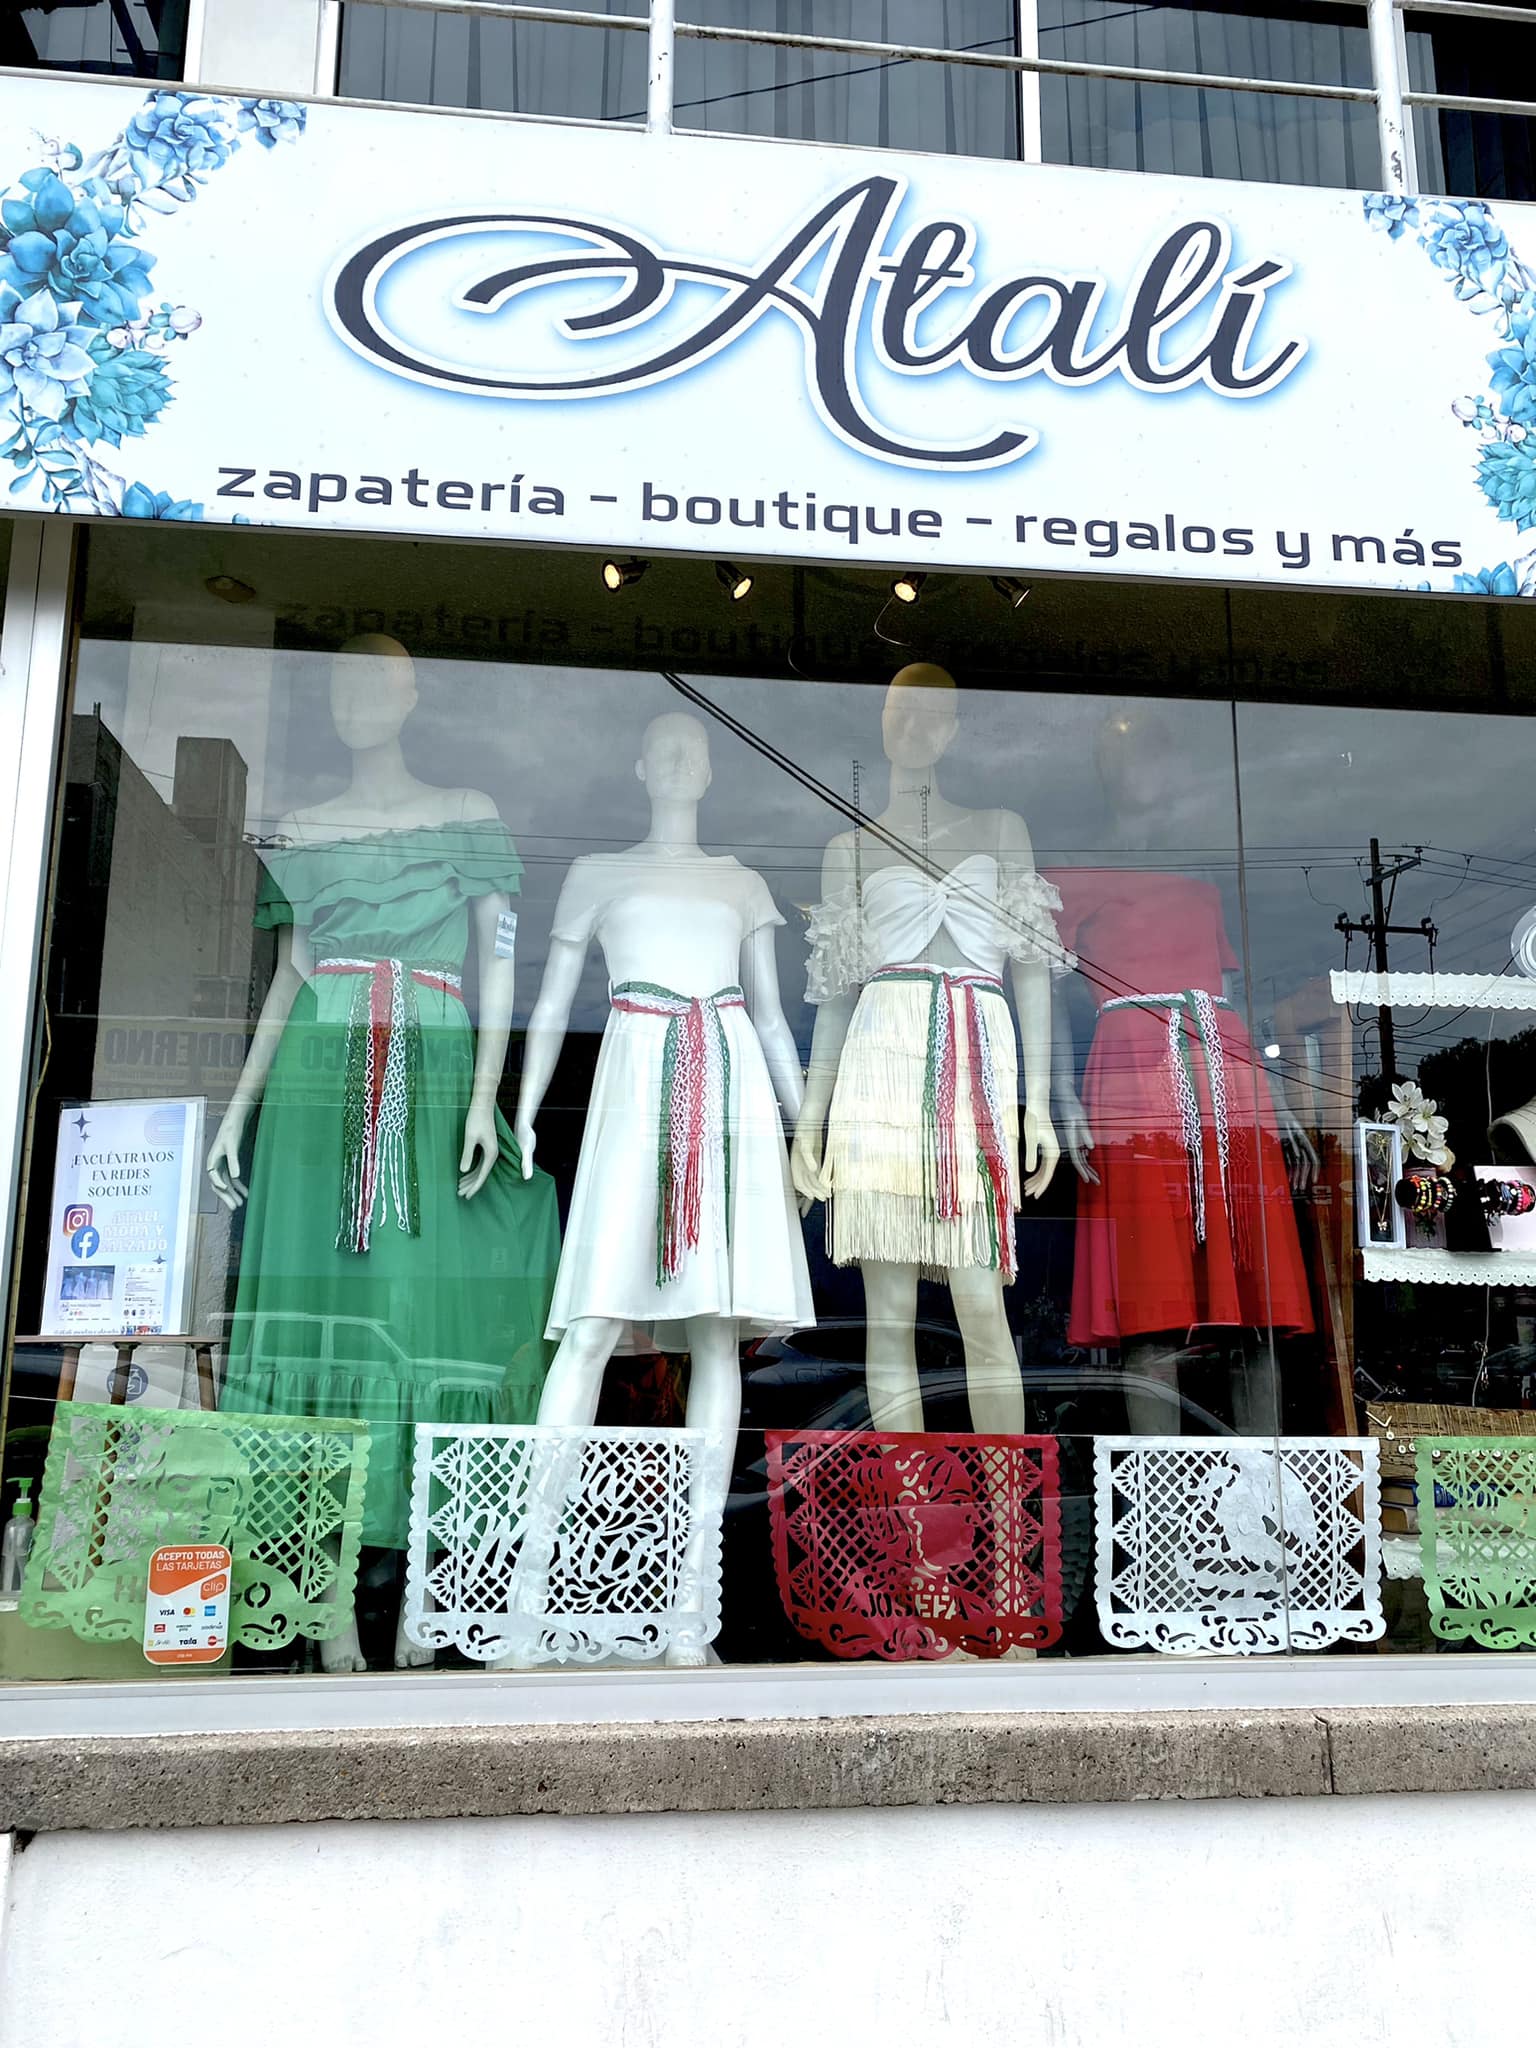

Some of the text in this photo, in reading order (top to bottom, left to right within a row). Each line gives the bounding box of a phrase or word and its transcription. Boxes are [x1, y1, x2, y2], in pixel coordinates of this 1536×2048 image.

[334, 177, 1299, 463] Atalí
[216, 467, 565, 516] zapatería
[642, 482, 942, 545] boutique
[1015, 513, 1254, 558] regalos
[1276, 531, 1311, 569] y
[1331, 526, 1462, 568] más
[92, 1168, 150, 1181] EN REDES
[87, 1184, 153, 1198] SOCIALES!
[157, 1550, 225, 1561] ACEPTO TODAS
[156, 1561, 222, 1572] LAS TARJETAS
[202, 1581, 225, 1593] clip
